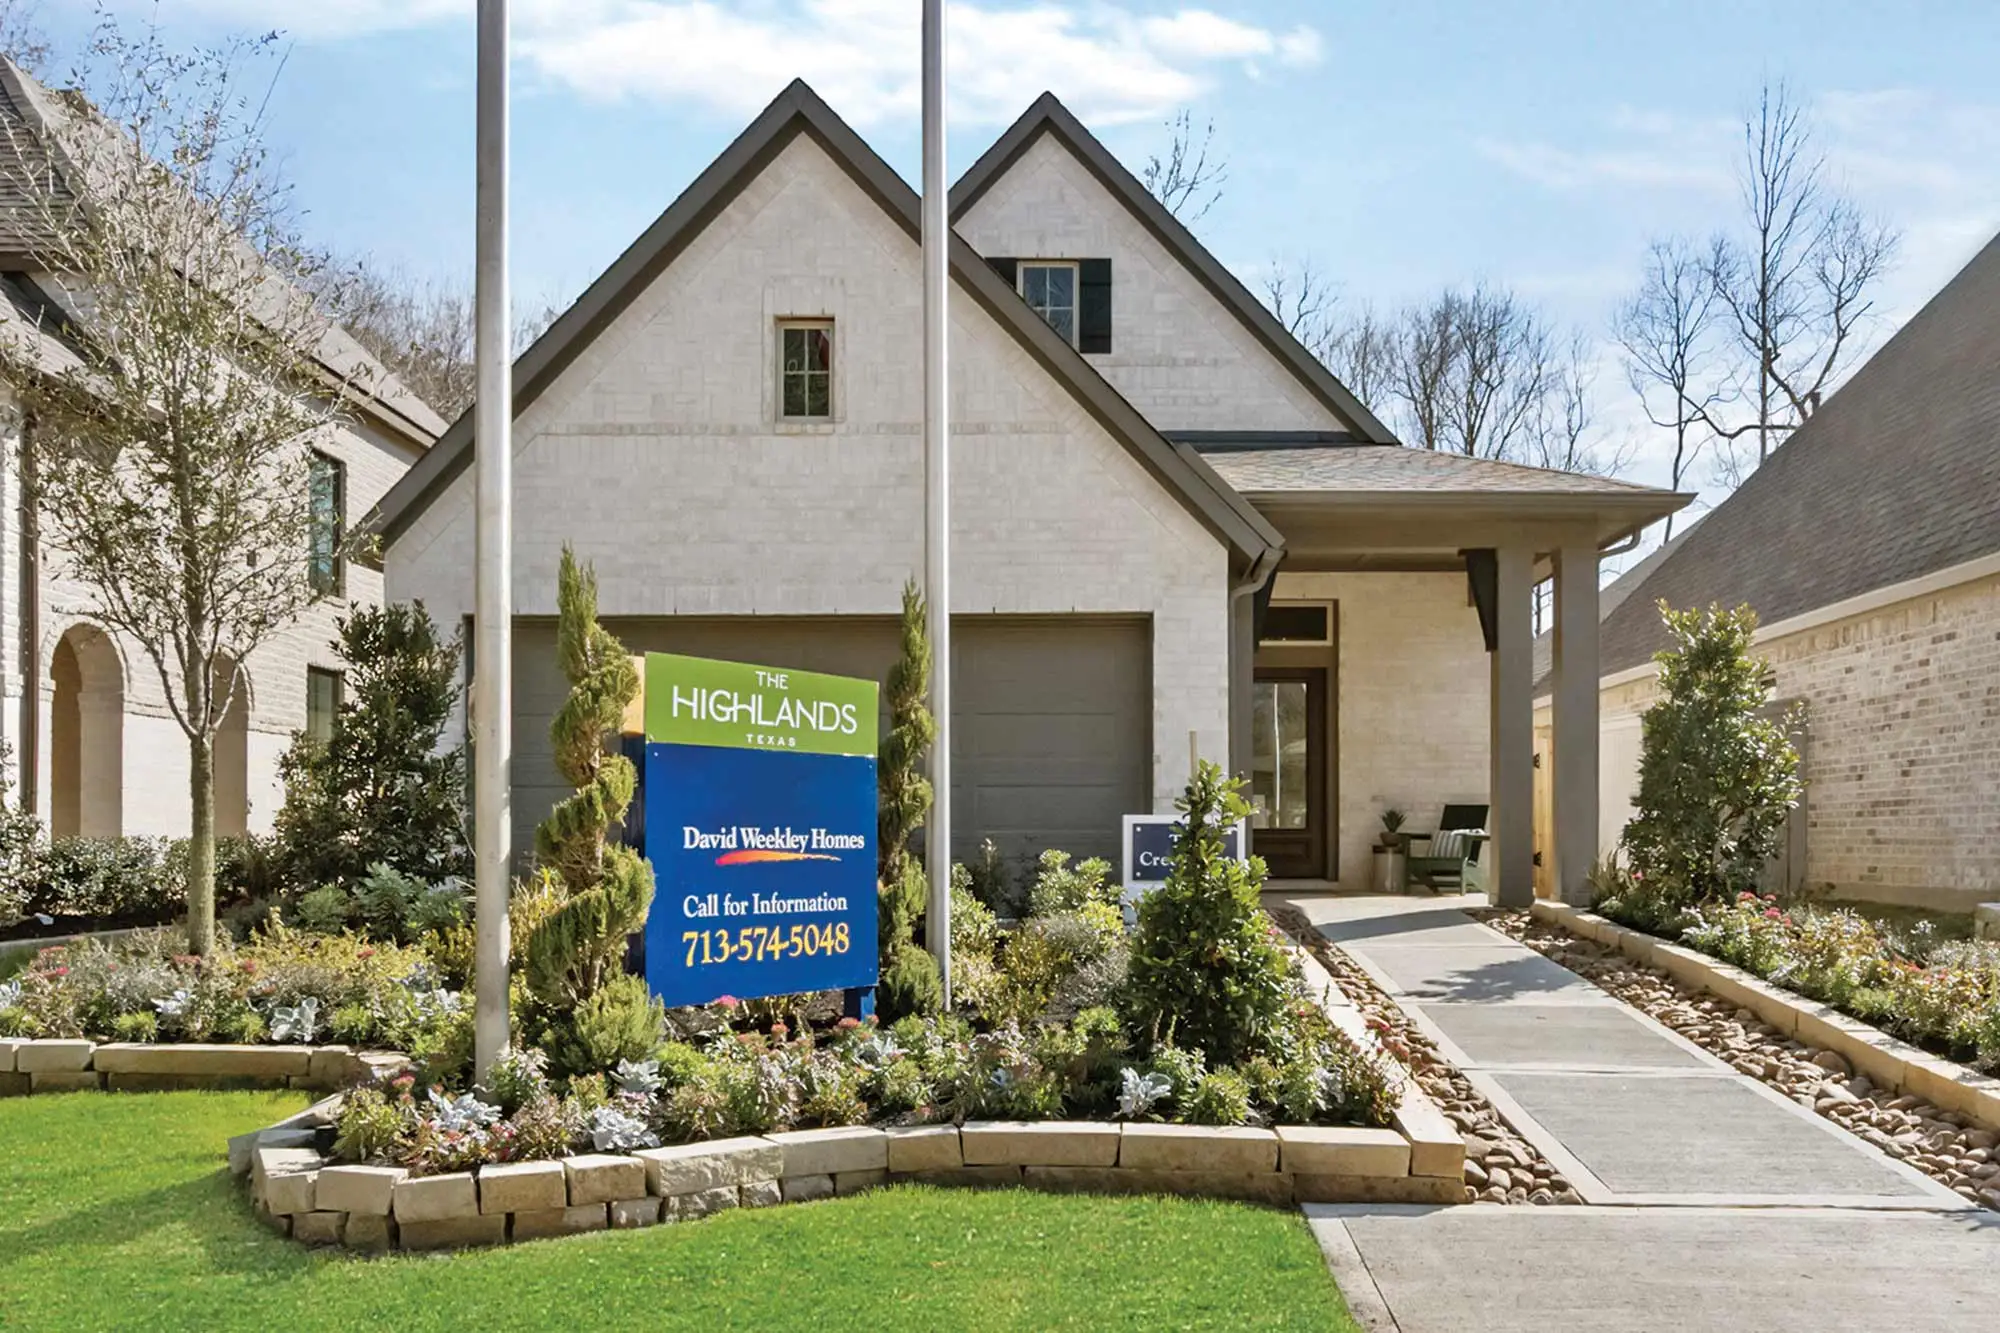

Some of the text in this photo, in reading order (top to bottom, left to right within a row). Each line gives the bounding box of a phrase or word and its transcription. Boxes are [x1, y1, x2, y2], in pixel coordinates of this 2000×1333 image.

[756, 671, 788, 690] THE
[673, 685, 858, 734] HIGHLANDS
[747, 734, 796, 747] TEXAS
[683, 826, 865, 853] David Weekley Homes
[683, 892, 848, 918] Call for Information
[682, 922, 850, 967] 713-574-5048
